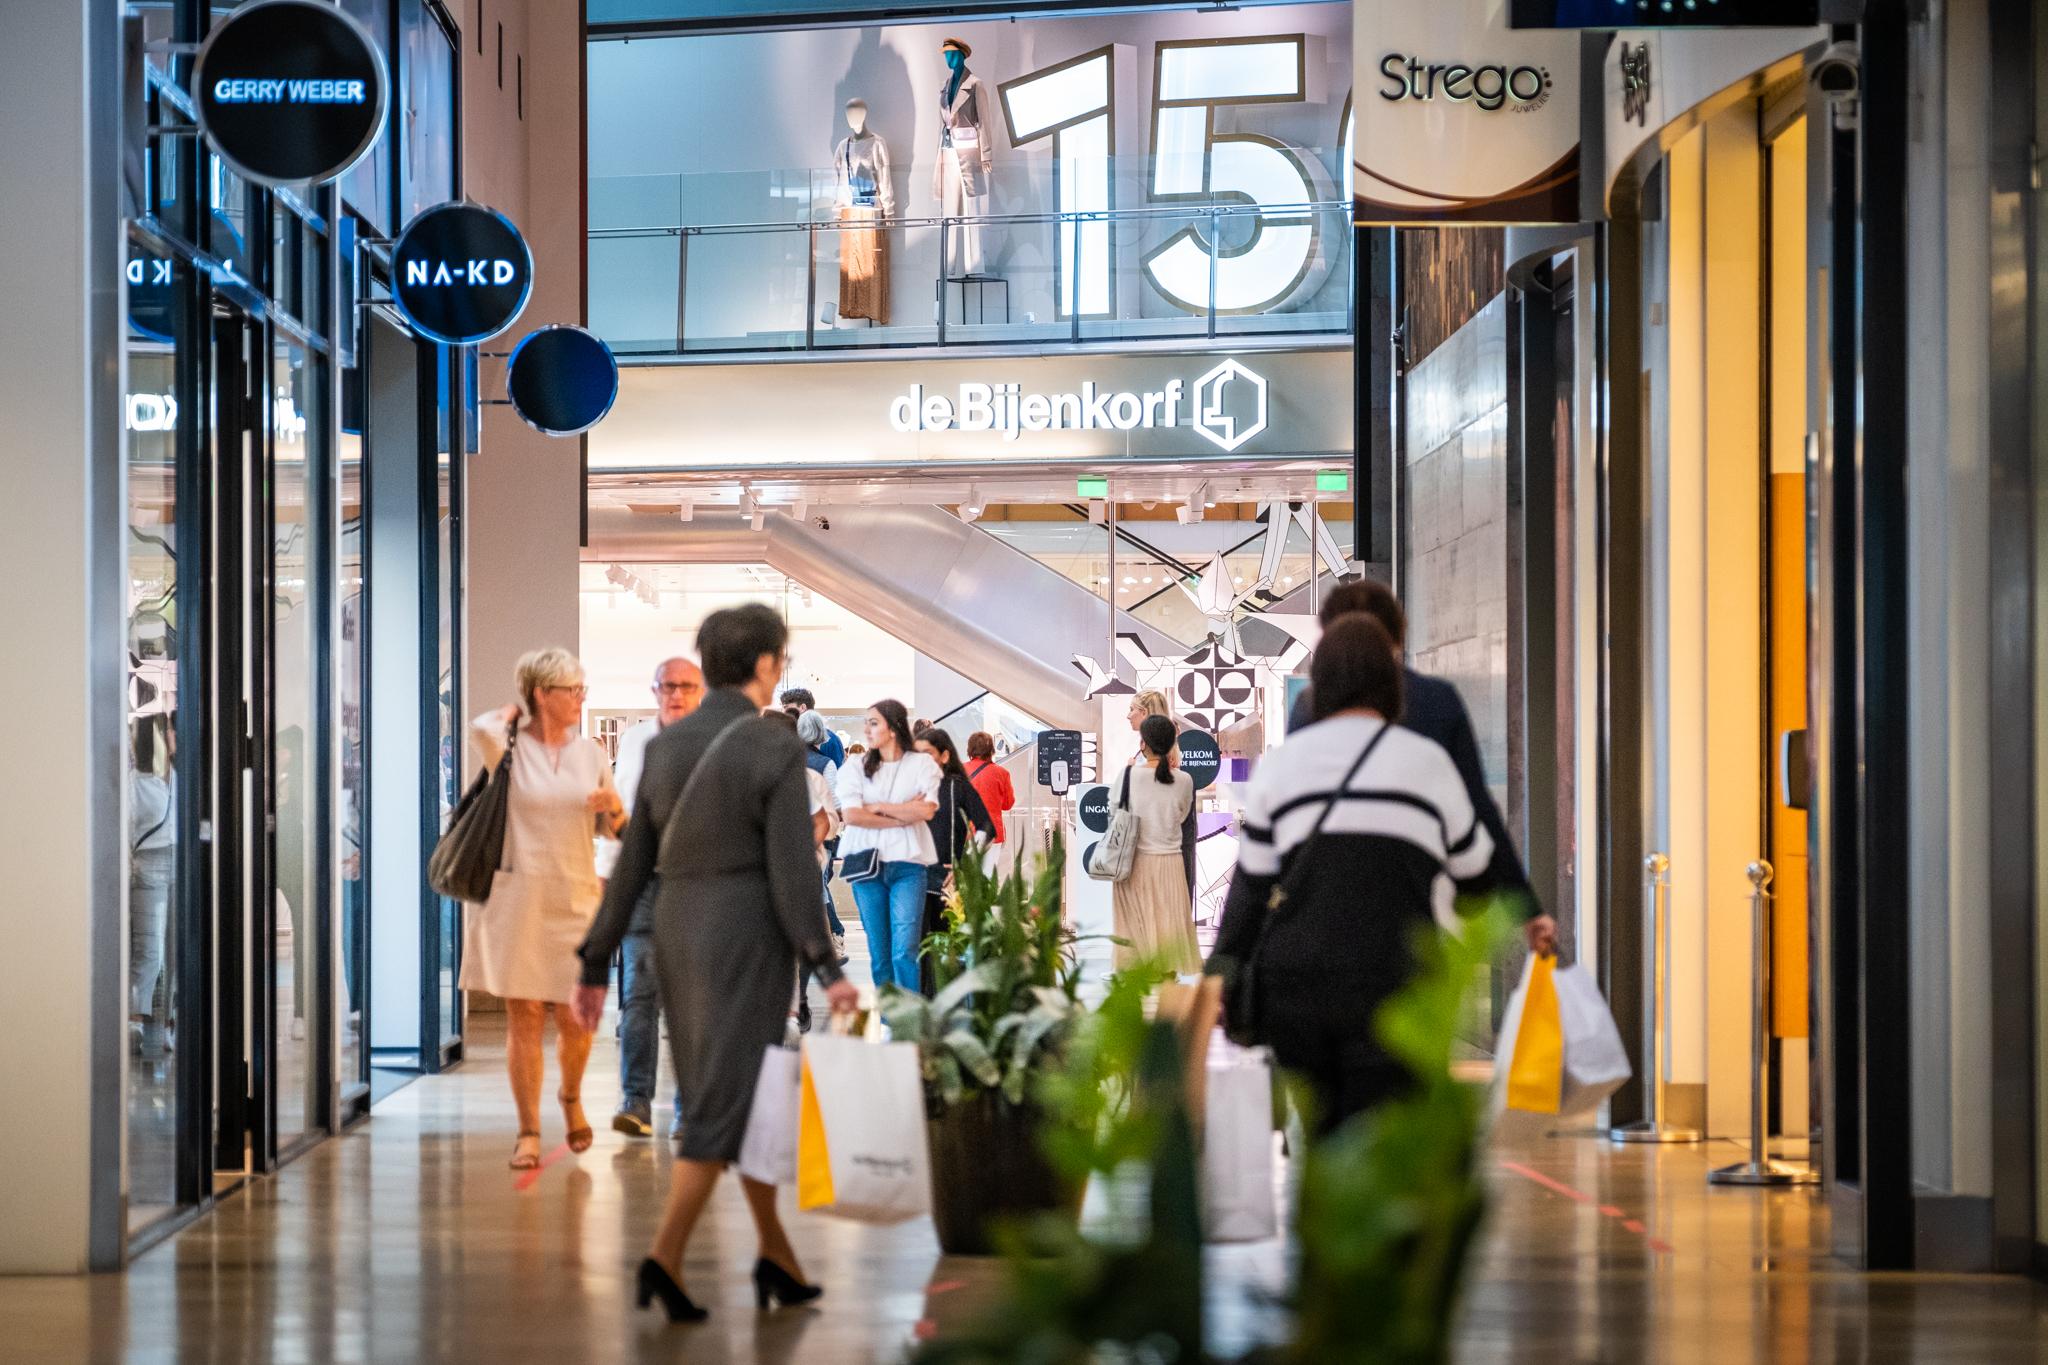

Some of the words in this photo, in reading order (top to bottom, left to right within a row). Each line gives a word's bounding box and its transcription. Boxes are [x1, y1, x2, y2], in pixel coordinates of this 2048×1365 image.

[214, 78, 286, 103] GERRY
[288, 78, 366, 104] WEBER
[1379, 53, 1544, 111] Strego
[1511, 91, 1552, 113] JUWELIER
[997, 33, 1352, 322] 15
[407, 260, 515, 286] NA-KD
[890, 384, 954, 432] de
[959, 379, 1184, 441] Bijenkorf
